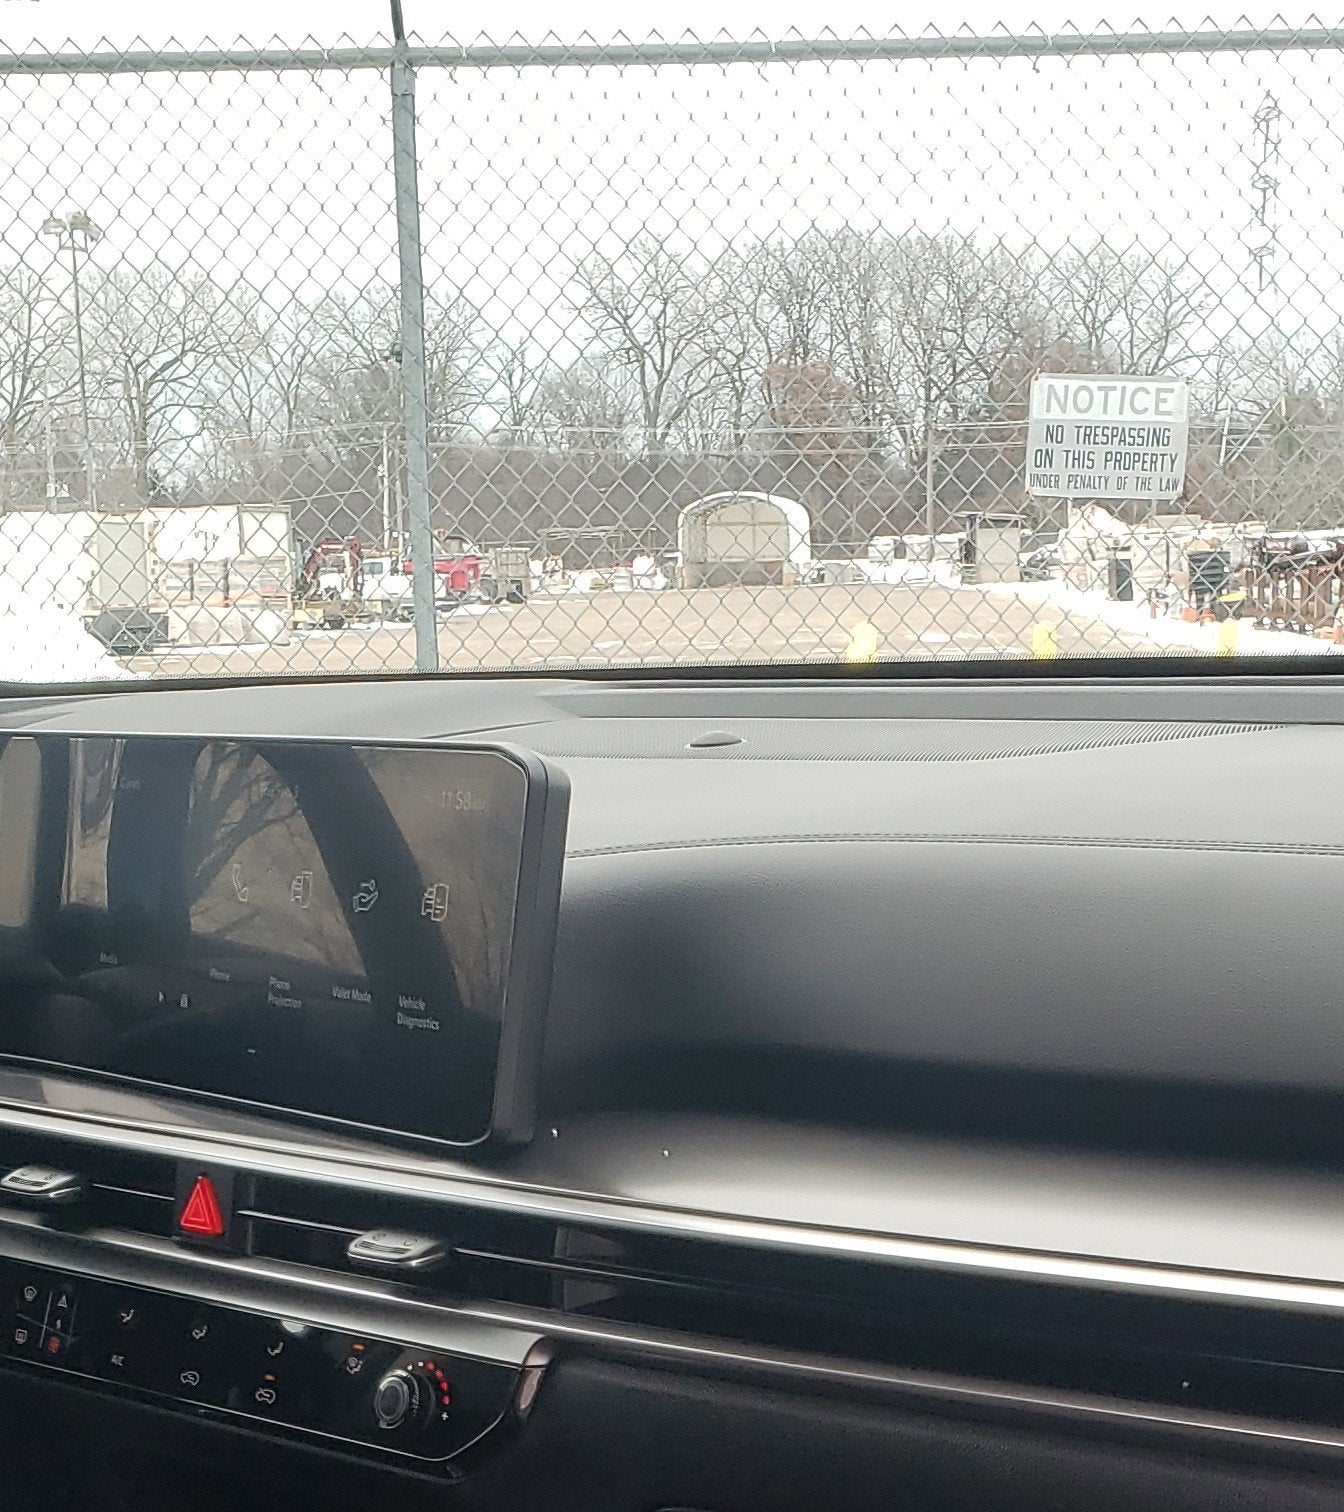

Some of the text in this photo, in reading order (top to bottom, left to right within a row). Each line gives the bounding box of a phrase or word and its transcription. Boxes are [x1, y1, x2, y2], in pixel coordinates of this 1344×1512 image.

[1046, 384, 1175, 416] NOTICE
[1045, 425, 1171, 447] NO TRESPASSING
[1034, 449, 1178, 472] ON THIS PROPERTY
[1030, 473, 1180, 492] UNDER PENALTY OF THE LAW
[397, 1012, 440, 1031] Diagnostics
